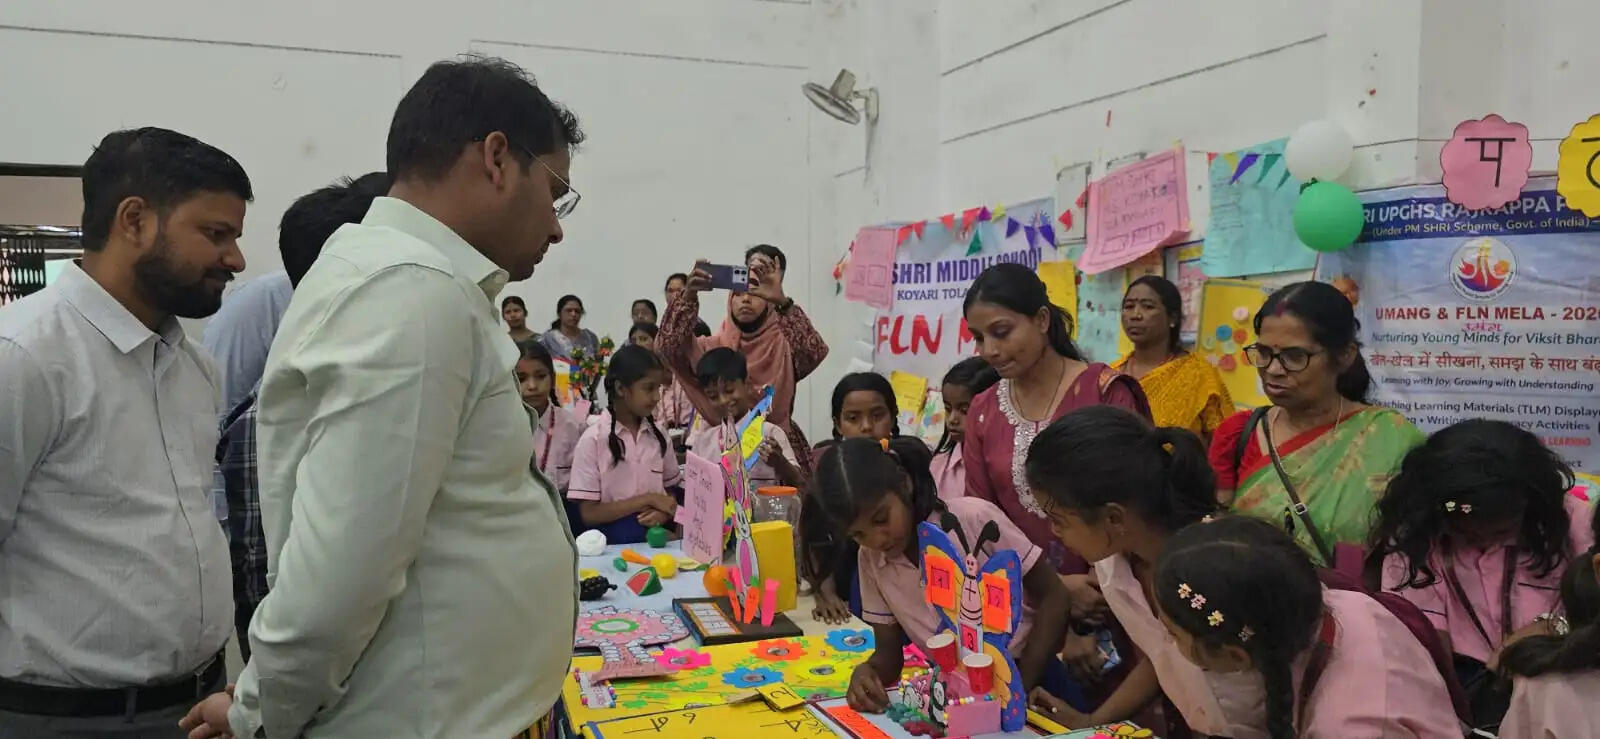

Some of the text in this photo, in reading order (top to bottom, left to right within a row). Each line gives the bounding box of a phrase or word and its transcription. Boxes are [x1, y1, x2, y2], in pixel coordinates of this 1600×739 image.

[1464, 137, 1516, 187] प
[1364, 209, 1375, 223] RI
[1379, 203, 1435, 222] UPGHS
[1372, 227, 1402, 237] (Under
[1404, 224, 1420, 233] PM
[1423, 222, 1450, 233] SHRI
[1507, 218, 1536, 230] Govt.
[1540, 217, 1552, 228] of
[1555, 216, 1590, 228] India)
[897, 289, 938, 301] KOYARI
[1376, 307, 1430, 320] UMANG
[1437, 307, 1448, 320] &
[1456, 306, 1488, 320] FLN
[1495, 306, 1545, 320] MELA
[1563, 306, 1600, 320] 202
[877, 314, 943, 355] FLN
[1372, 331, 1600, 346] Nurturing Young Minds for Viksit Bhar
[1417, 351, 1432, 368] में
[1488, 356, 1525, 373] समझ
[1529, 352, 1545, 370] के
[1548, 358, 1577, 372] साथ
[1413, 377, 1433, 386] with
[1454, 378, 1493, 389] Growing
[1496, 378, 1516, 388] with
[1519, 379, 1594, 392] Understanding
[1414, 401, 1460, 413] Learning
[1464, 402, 1514, 414] Materials
[1518, 404, 1551, 416] (TLM)
[1555, 406, 1600, 418] Display
[1536, 420, 1590, 431] Activities
